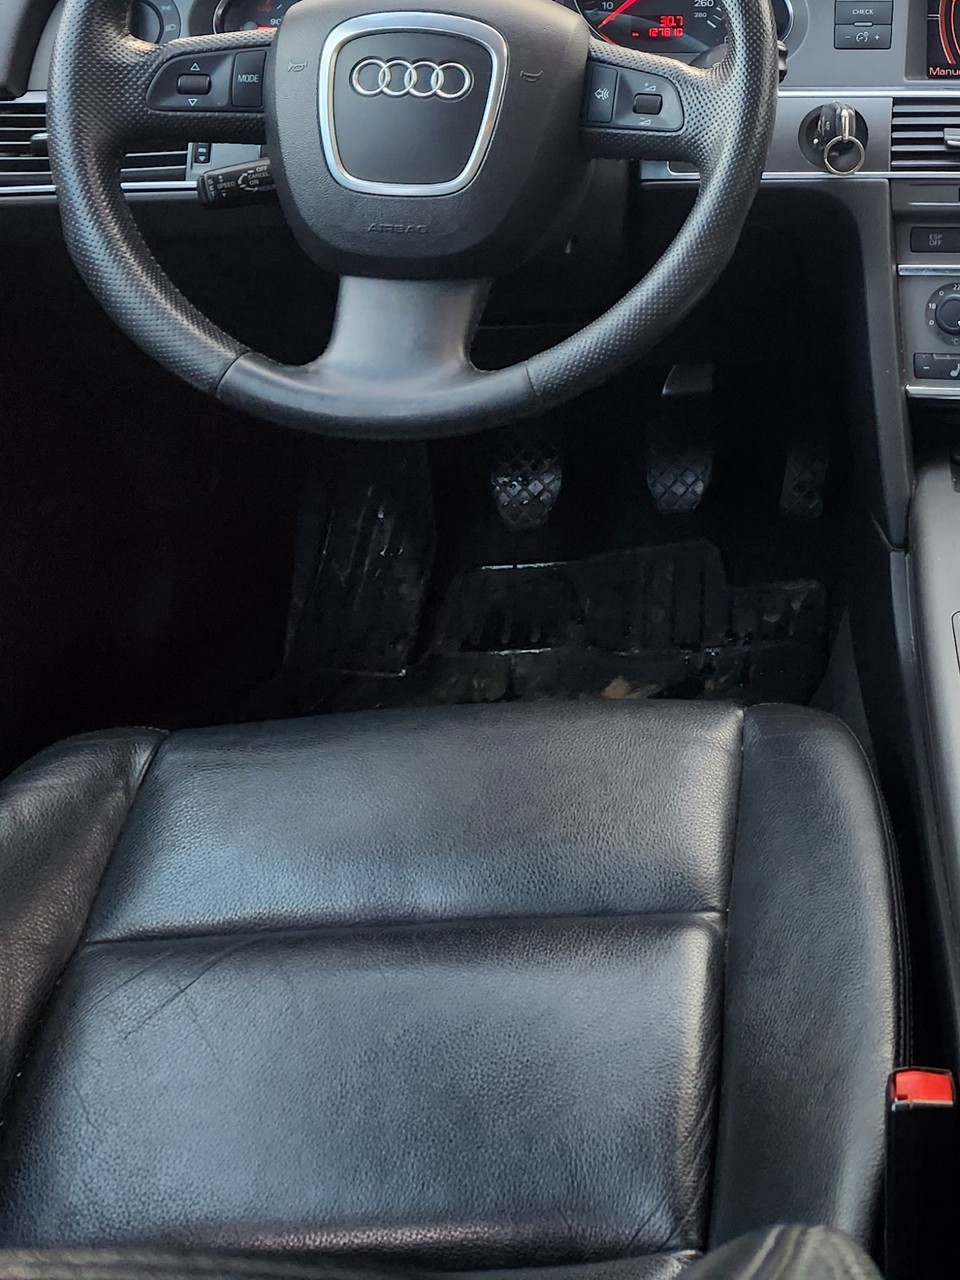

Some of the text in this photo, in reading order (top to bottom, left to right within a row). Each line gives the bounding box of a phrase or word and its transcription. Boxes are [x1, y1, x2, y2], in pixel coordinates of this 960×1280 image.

[602, 1, 614, 10] 10
[693, 0, 714, 8] 260
[237, 74, 259, 83] MODE
